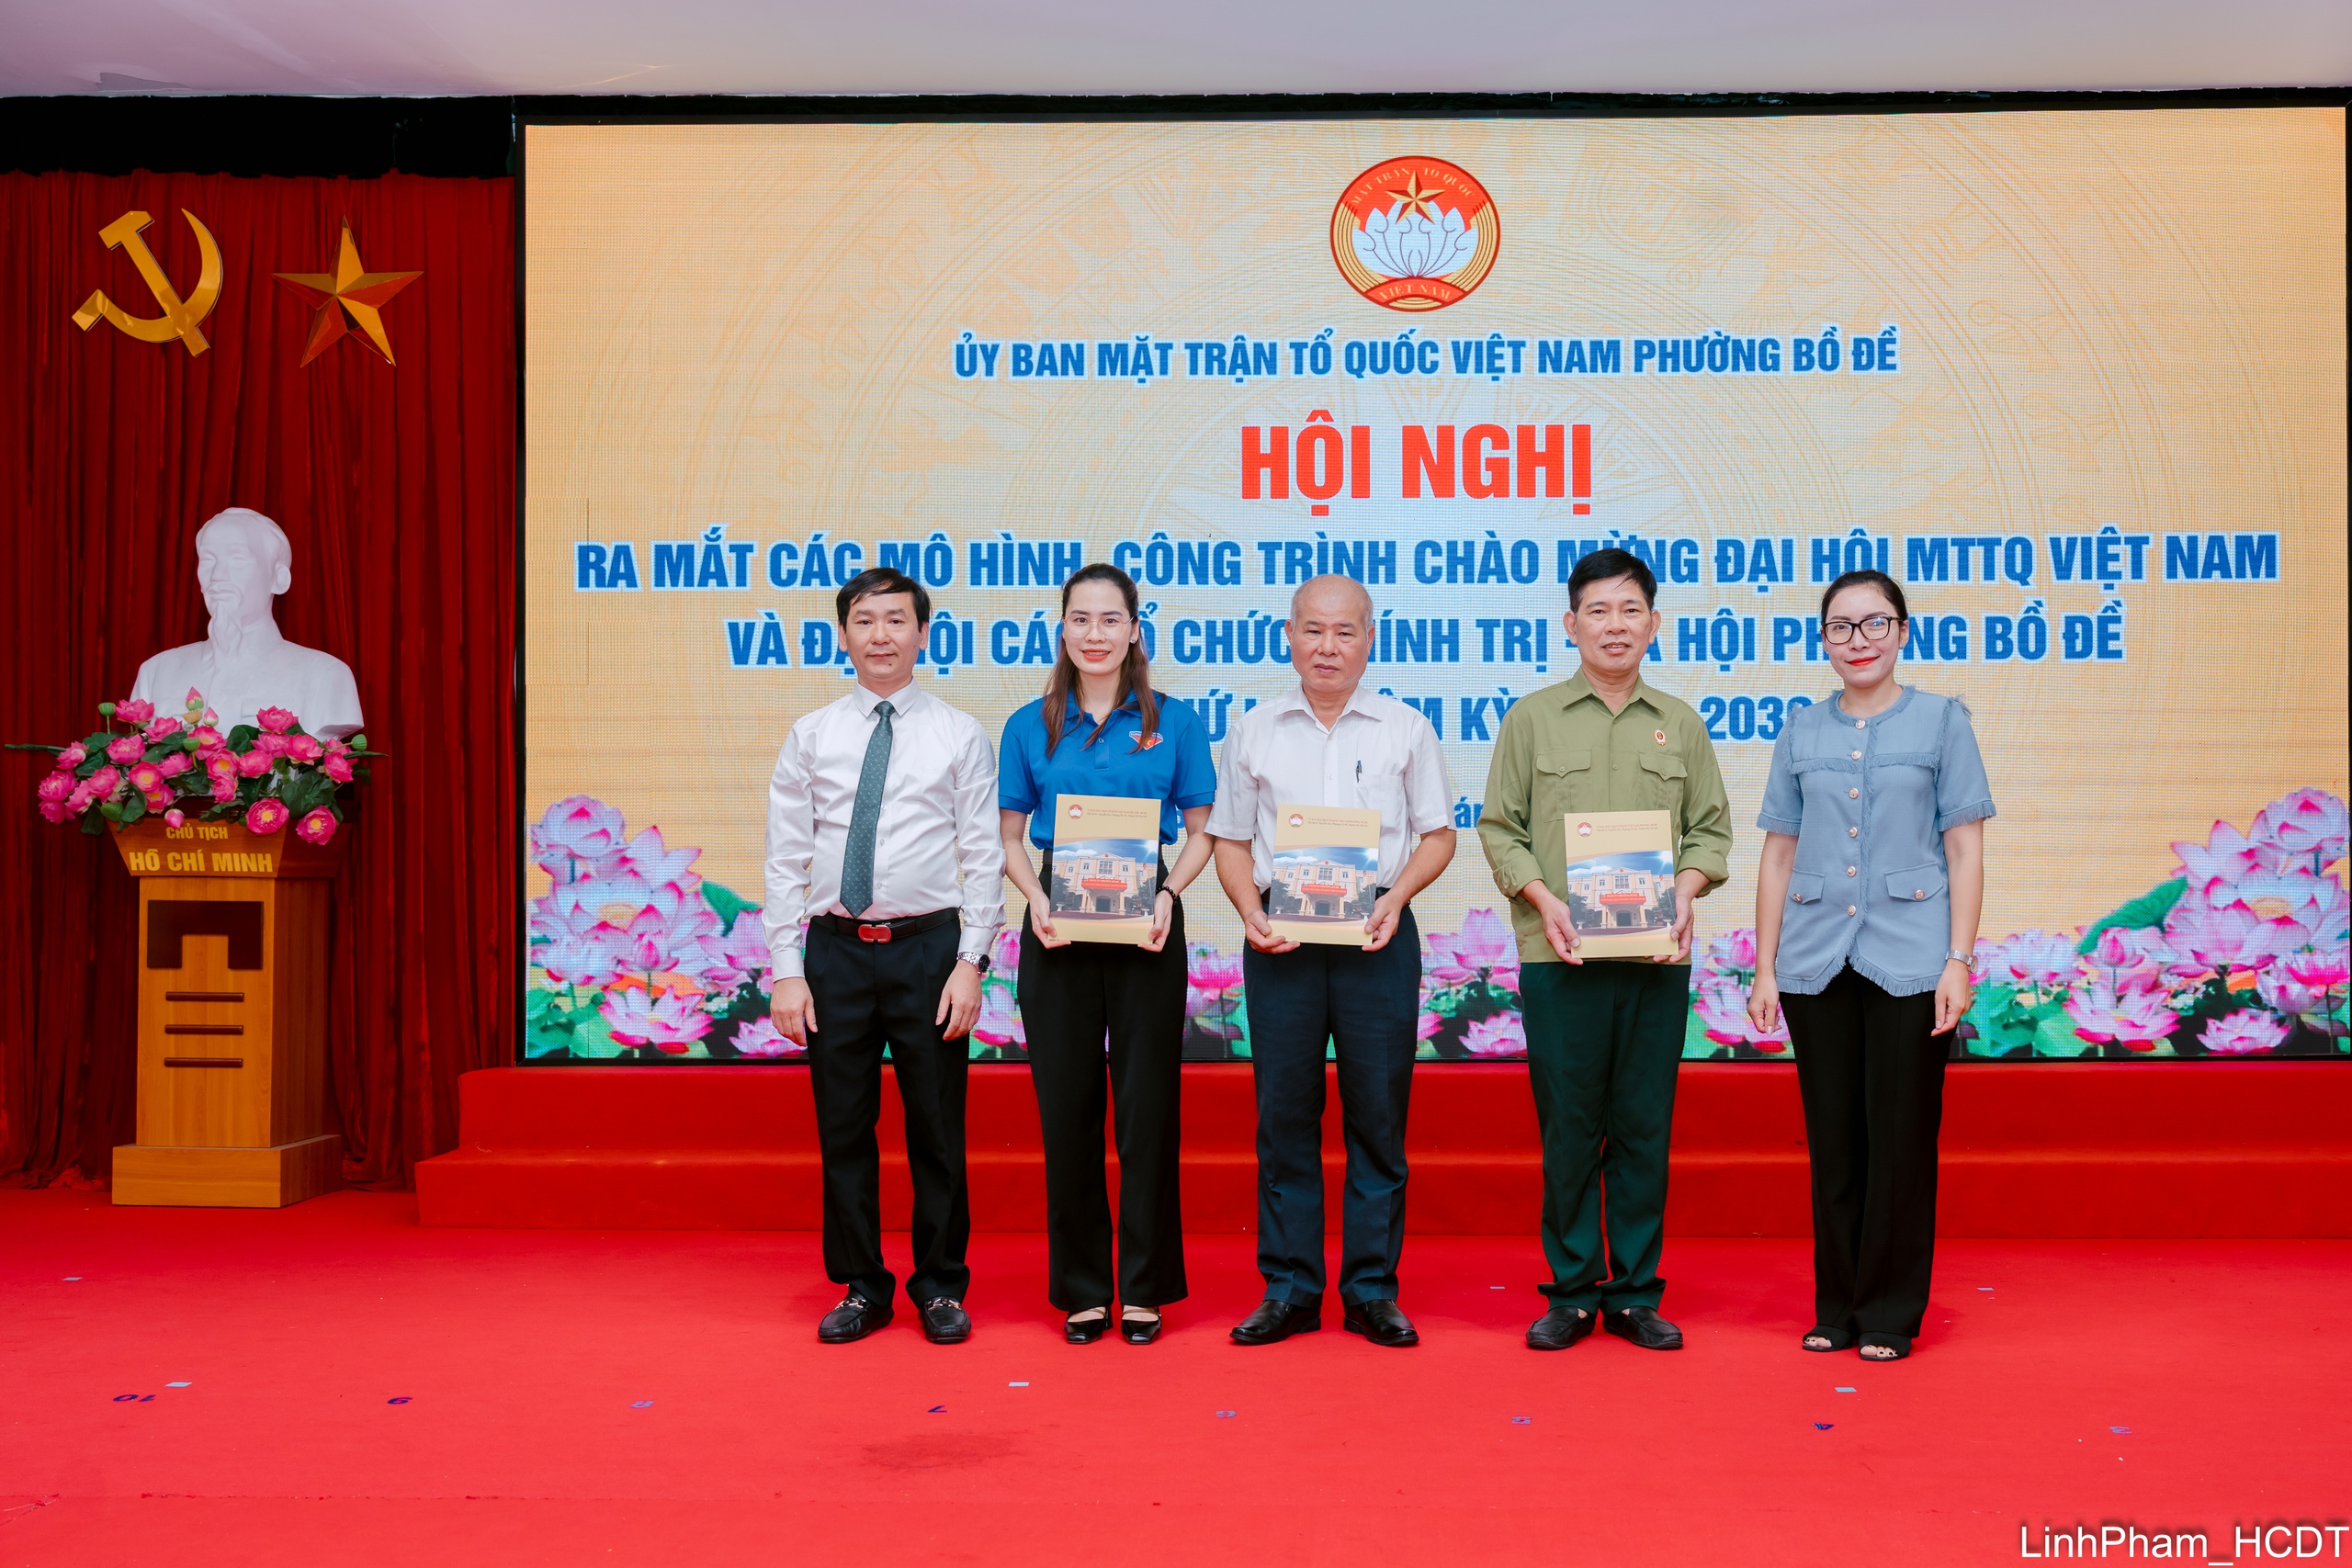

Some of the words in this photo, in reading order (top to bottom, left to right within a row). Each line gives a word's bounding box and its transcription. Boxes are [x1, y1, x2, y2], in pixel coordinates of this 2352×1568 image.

[1419, 284, 1450, 299] NAM
[956, 332, 1000, 378] ỦY
[1012, 343, 1085, 377] BAN
[1097, 335, 1174, 383] MẶT
[1184, 334, 1278, 383] TRẬN
[1289, 327, 1334, 376] TỔ
[1344, 328, 1440, 379] QUỐC
[1451, 333, 1527, 382] VIỆT
[1538, 339, 1621, 374] NAM
[1634, 331, 1781, 373] PHƯỜNG
[1792, 326, 1840, 372] BỒ
[1851, 325, 1897, 371] ĐỀ
[1241, 409, 1370, 516] HỘI
[1402, 423, 1591, 515] NGHỊ
[577, 544, 639, 589] RA
[653, 526, 754, 589] MẮT
[769, 534, 862, 588] CÁC
[969, 533, 1082, 587] HÌNH
[1113, 532, 1241, 586] CÔNG
[1257, 531, 1396, 585] TRÌNH
[1414, 530, 1540, 585] CHÀO
[1713, 538, 1794, 592] ĐẠI
[1906, 536, 2033, 587] MTTQ
[2049, 526, 2150, 591] VIỆT
[2165, 534, 2278, 580] NAM
[727, 612, 788, 666] VÀ
[915, 611, 974, 675] ỘI
[990, 611, 1063, 665] CÁ
[1368, 609, 1460, 663] ÍNH
[1475, 618, 1548, 673] TRỊ
[1678, 607, 1756, 672] HỘI
[1984, 600, 2047, 660] BỒ
[2062, 600, 2123, 660] ĐỀ
[166, 822, 195, 840] CHỦ
[197, 827, 229, 841] TỊCH
[166, 849, 206, 872] CHÍ
[210, 852, 274, 873] MINH
